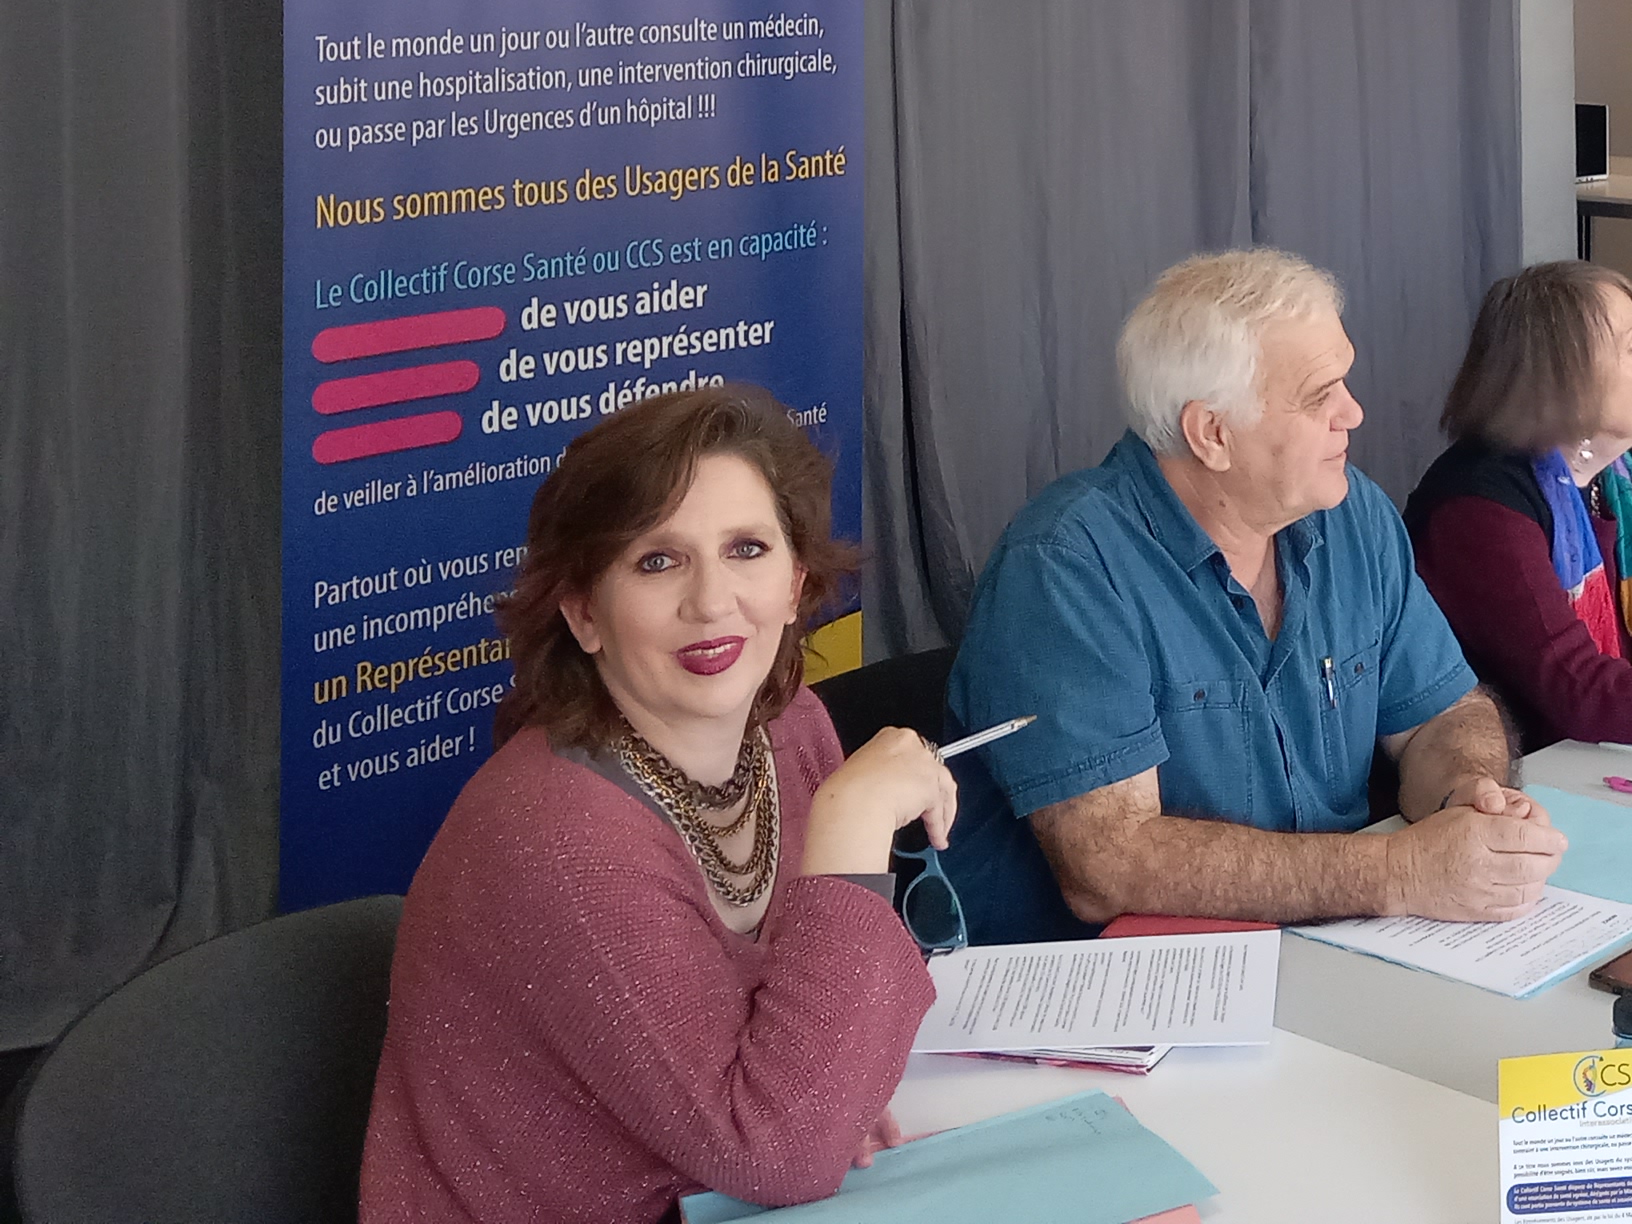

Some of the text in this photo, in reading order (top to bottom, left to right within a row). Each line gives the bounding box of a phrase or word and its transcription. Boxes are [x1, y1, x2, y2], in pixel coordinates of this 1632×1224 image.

[315, 12, 825, 63] Tout le monde un jour ou l'autre consulte un médecin,
[314, 48, 838, 106] subit une hospitalisation, une intervention chirurgicale,
[315, 93, 717, 152] ou passe par les Urgences d'un hôpital !!!
[315, 145, 847, 230] Nous sommes tous des Usagers de la Santé
[315, 278, 342, 310] Le
[348, 263, 448, 305] Collectif
[453, 258, 516, 291] Corse
[522, 246, 586, 284] Santé
[592, 251, 620, 275] ou
[626, 238, 665, 271] CCS
[669, 239, 702, 264] est
[707, 237, 734, 260] en
[738, 221, 817, 261] capacité
[520, 280, 709, 332] de vous aider
[499, 316, 775, 383] de vous représenter
[481, 401, 519, 434] de
[526, 394, 591, 428] vous
[314, 490, 338, 515] de
[343, 479, 402, 510] veiller
[406, 474, 417, 496] à
[423, 454, 550, 495] l'amélioration
[314, 567, 398, 608] Partout
[404, 558, 432, 588] où
[438, 552, 489, 581] vous
[314, 624, 356, 653] une
[314, 638, 511, 704] un Représenta
[313, 683, 504, 748] du Collectif Corse
[318, 726, 475, 790] et vous aider !
[1511, 1100, 1587, 1124] Collectif
